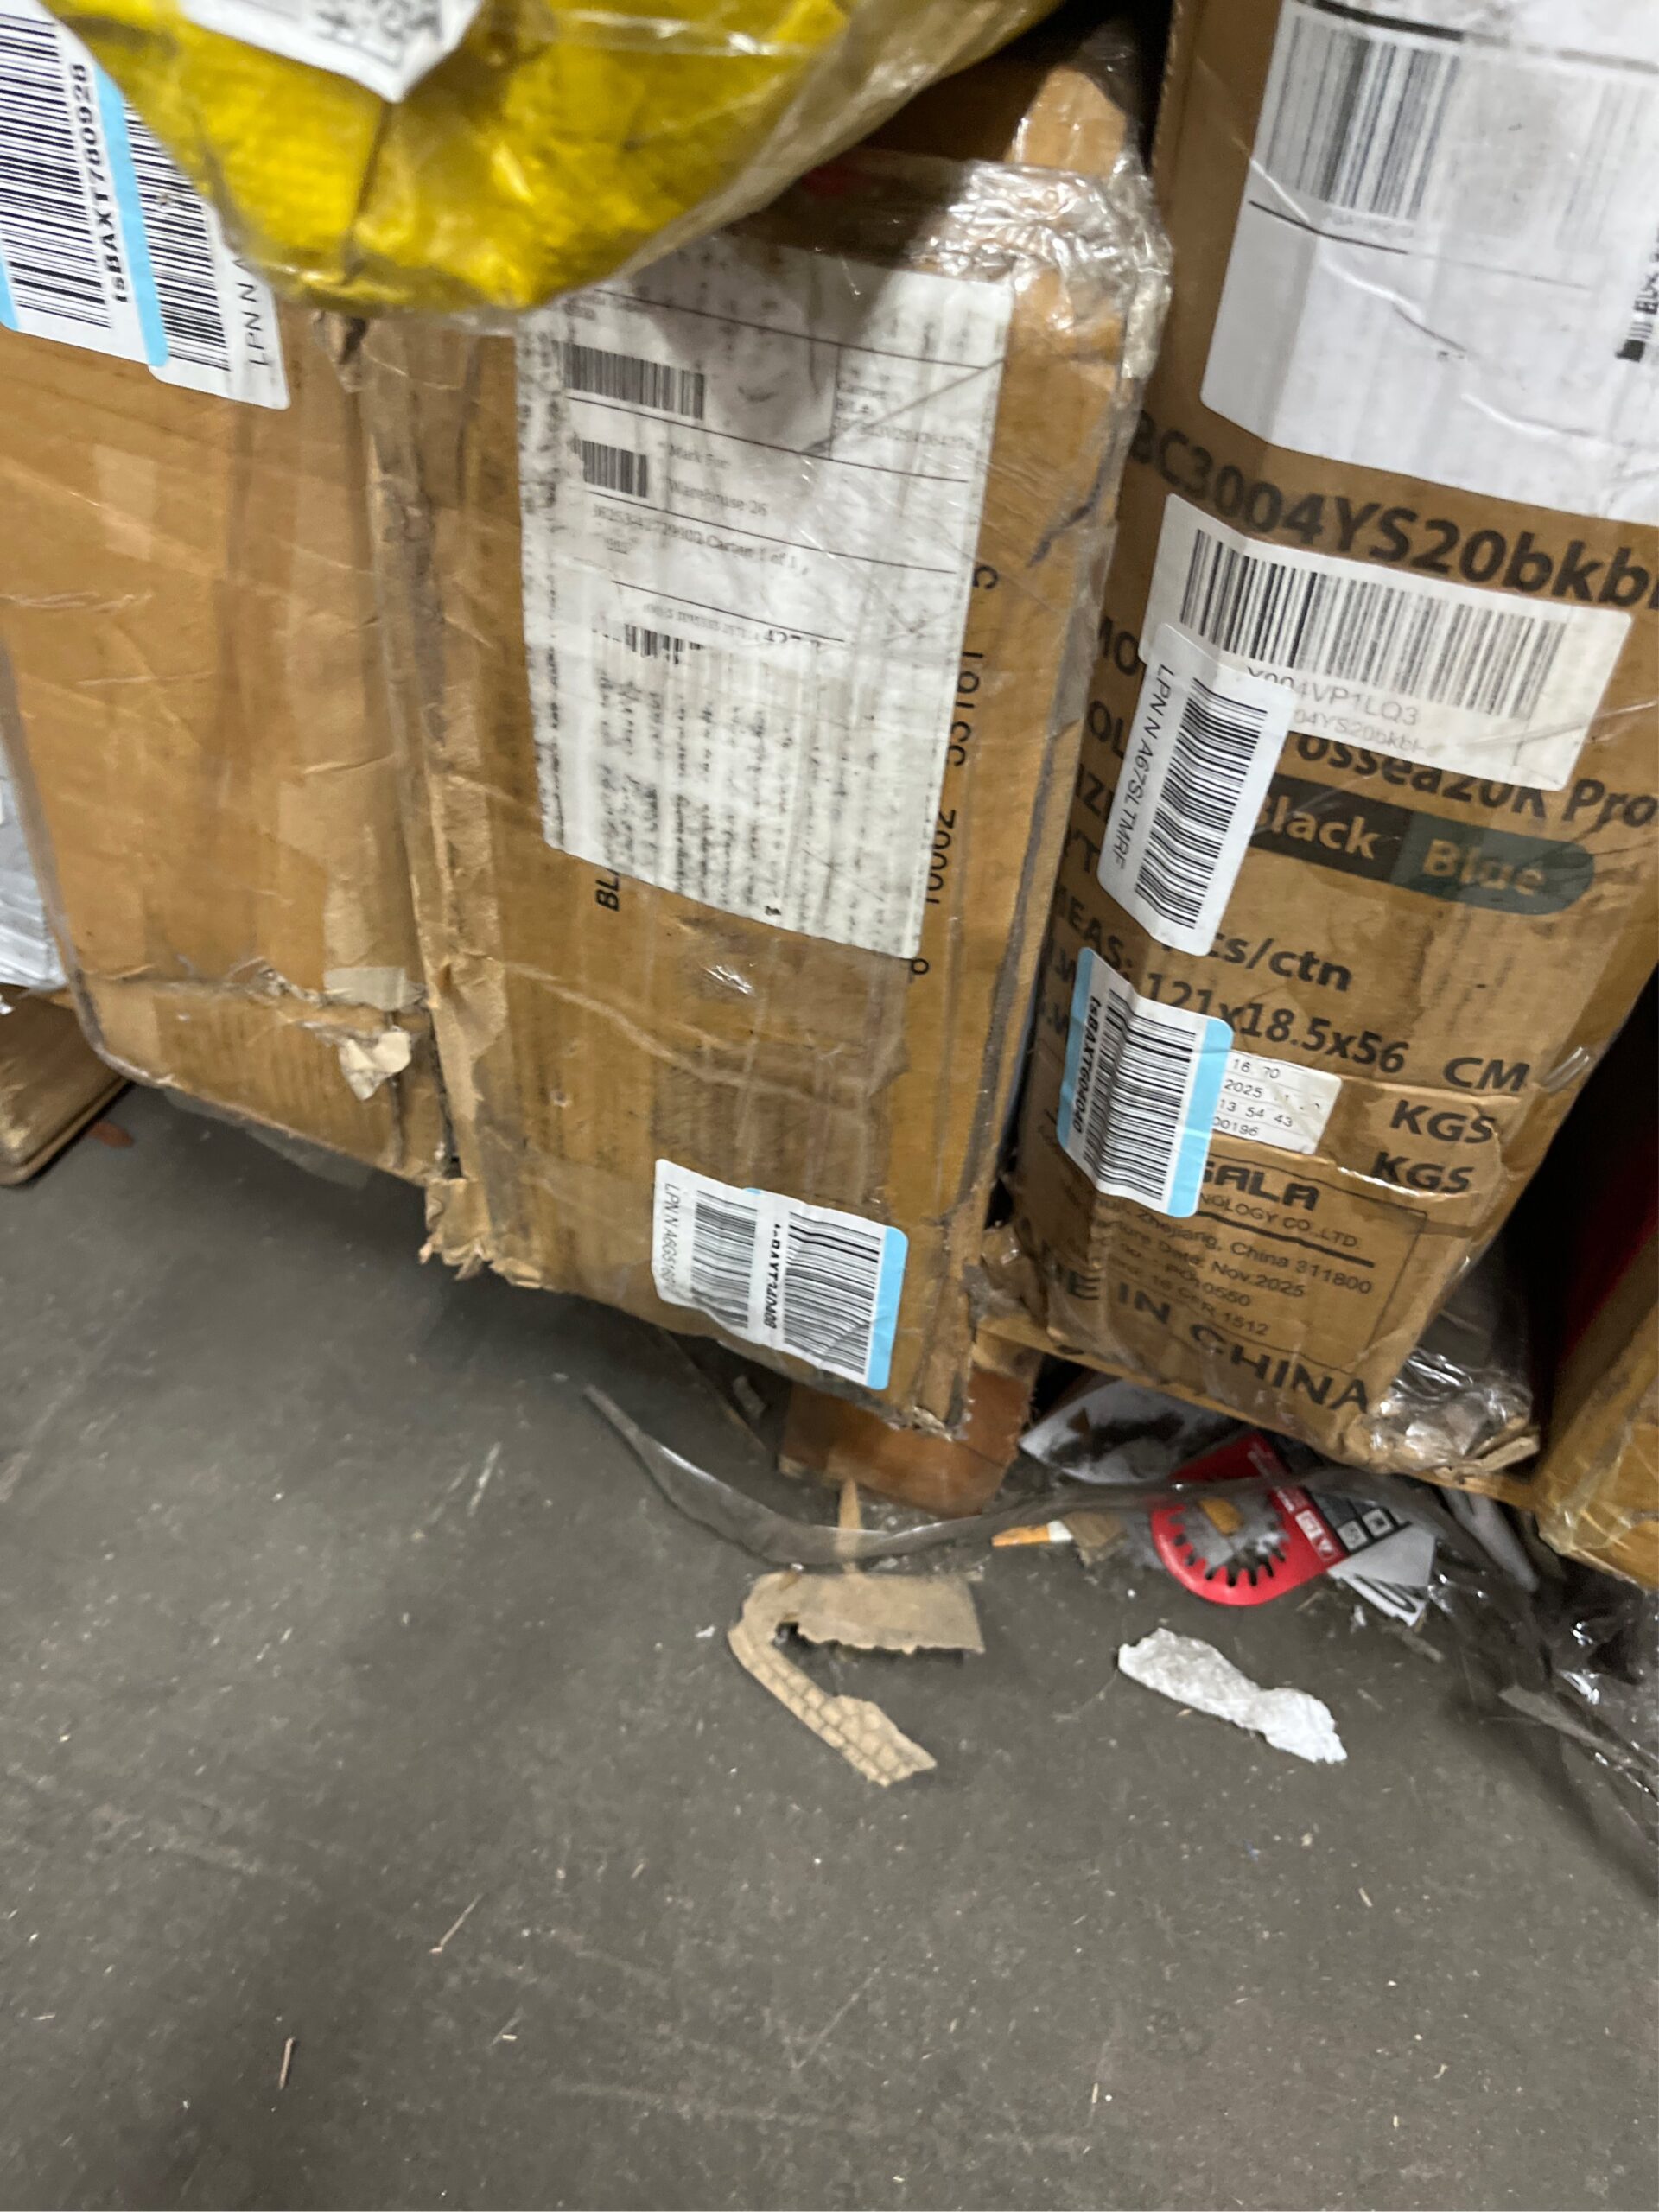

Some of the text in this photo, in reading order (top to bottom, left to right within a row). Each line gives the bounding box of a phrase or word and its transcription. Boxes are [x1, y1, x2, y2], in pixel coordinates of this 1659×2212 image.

[1126, 410, 1659, 609] BC3004YS20bkb
[1150, 664, 1176, 717] LPN
[594, 870, 621, 912] BL
[1224, 1077, 1263, 1099] 2025
[1443, 1057, 1529, 1092] CM
[1274, 1112, 1294, 1128] 43
[1391, 1099, 1496, 1144] KGS
[1371, 1151, 1473, 1194] KGS
[663, 1183, 680, 1211] LPN
[1230, 1238, 1290, 1271] China
[1294, 1254, 1373, 1295] 311800
[1118, 1282, 1370, 1413] IN CHINA
